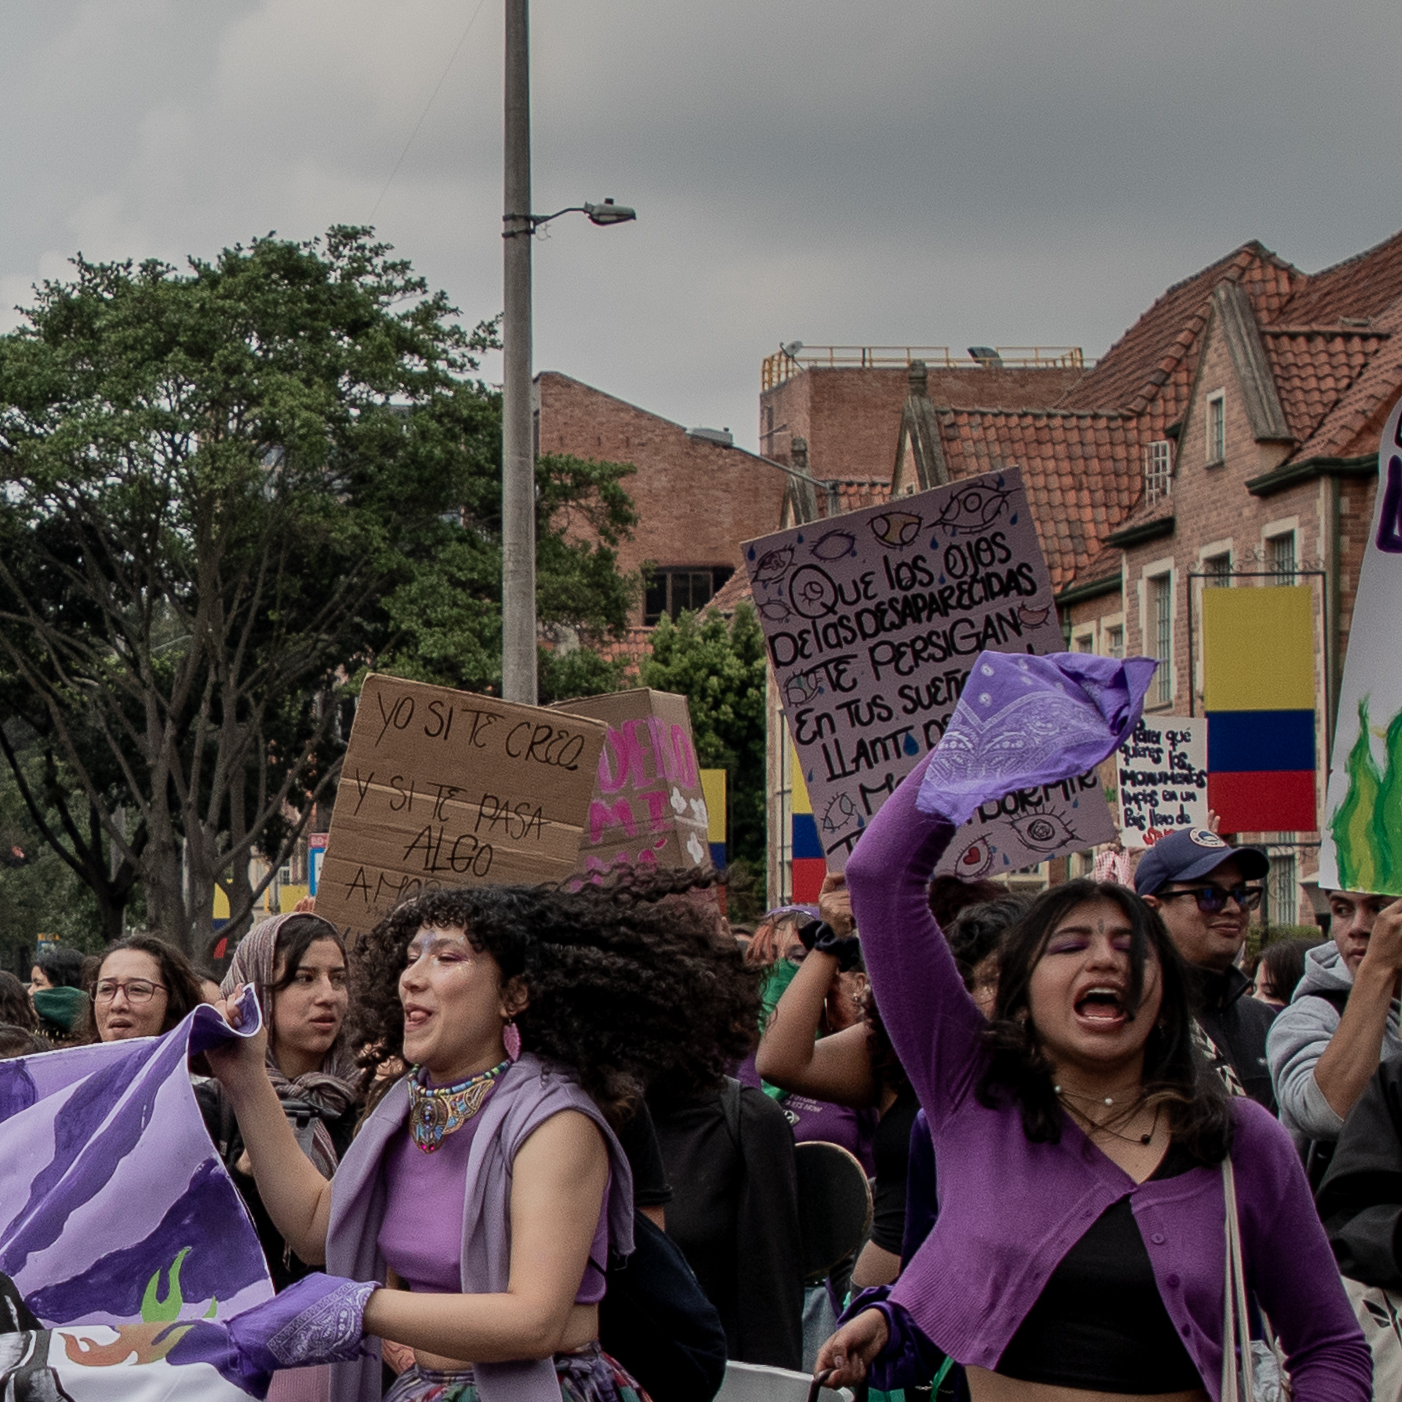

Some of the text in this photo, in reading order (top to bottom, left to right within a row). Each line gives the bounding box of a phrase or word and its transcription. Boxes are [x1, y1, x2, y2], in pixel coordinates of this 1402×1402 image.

[854, 561, 1039, 642] DESAPARECIDAS
[798, 606, 1025, 693] TE PERSIGAN
[375, 692, 414, 747] YO
[424, 700, 453, 740] SI
[461, 708, 505, 748] TE
[835, 692, 894, 729] TUS
[354, 768, 552, 841] Y SI TE PASA
[403, 825, 493, 877] ALGO
